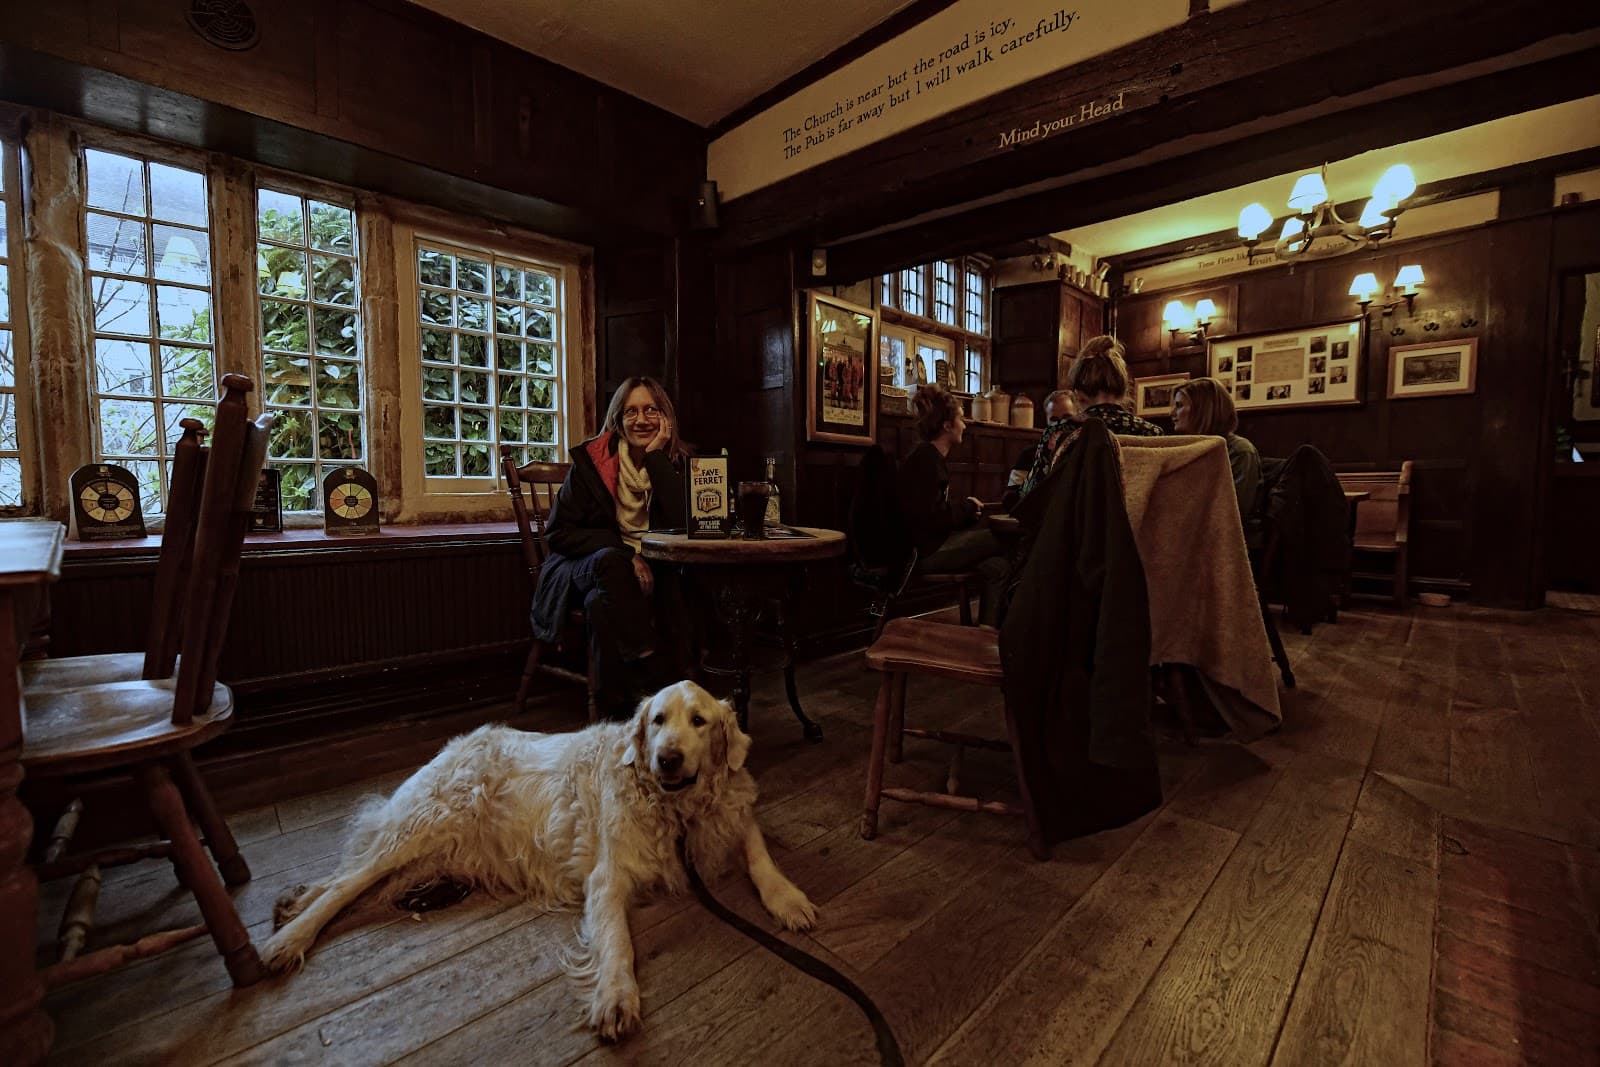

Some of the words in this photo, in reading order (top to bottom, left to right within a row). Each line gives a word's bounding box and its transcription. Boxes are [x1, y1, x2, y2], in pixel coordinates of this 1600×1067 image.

[782, 127, 801, 143] The
[804, 103, 843, 131] Church
[846, 98, 854, 111] is
[857, 84, 884, 105] near
[887, 70, 908, 90] but
[913, 56, 935, 75] the
[939, 34, 969, 63] road
[974, 30, 985, 45] is
[783, 144, 802, 160] The
[805, 130, 825, 150] Pub
[827, 127, 835, 139] is
[838, 118, 854, 134] far
[856, 102, 885, 124] away
[889, 88, 911, 108] but
[915, 80, 921, 94] I
[925, 66, 950, 89] will
[956, 47, 994, 75] walk
[1000, 9, 1081, 55] carefully.
[998, 120, 1042, 149] Mind
[1042, 114, 1077, 138] your
[1079, 92, 1126, 123] Head
[694, 476, 723, 486] FERRET
